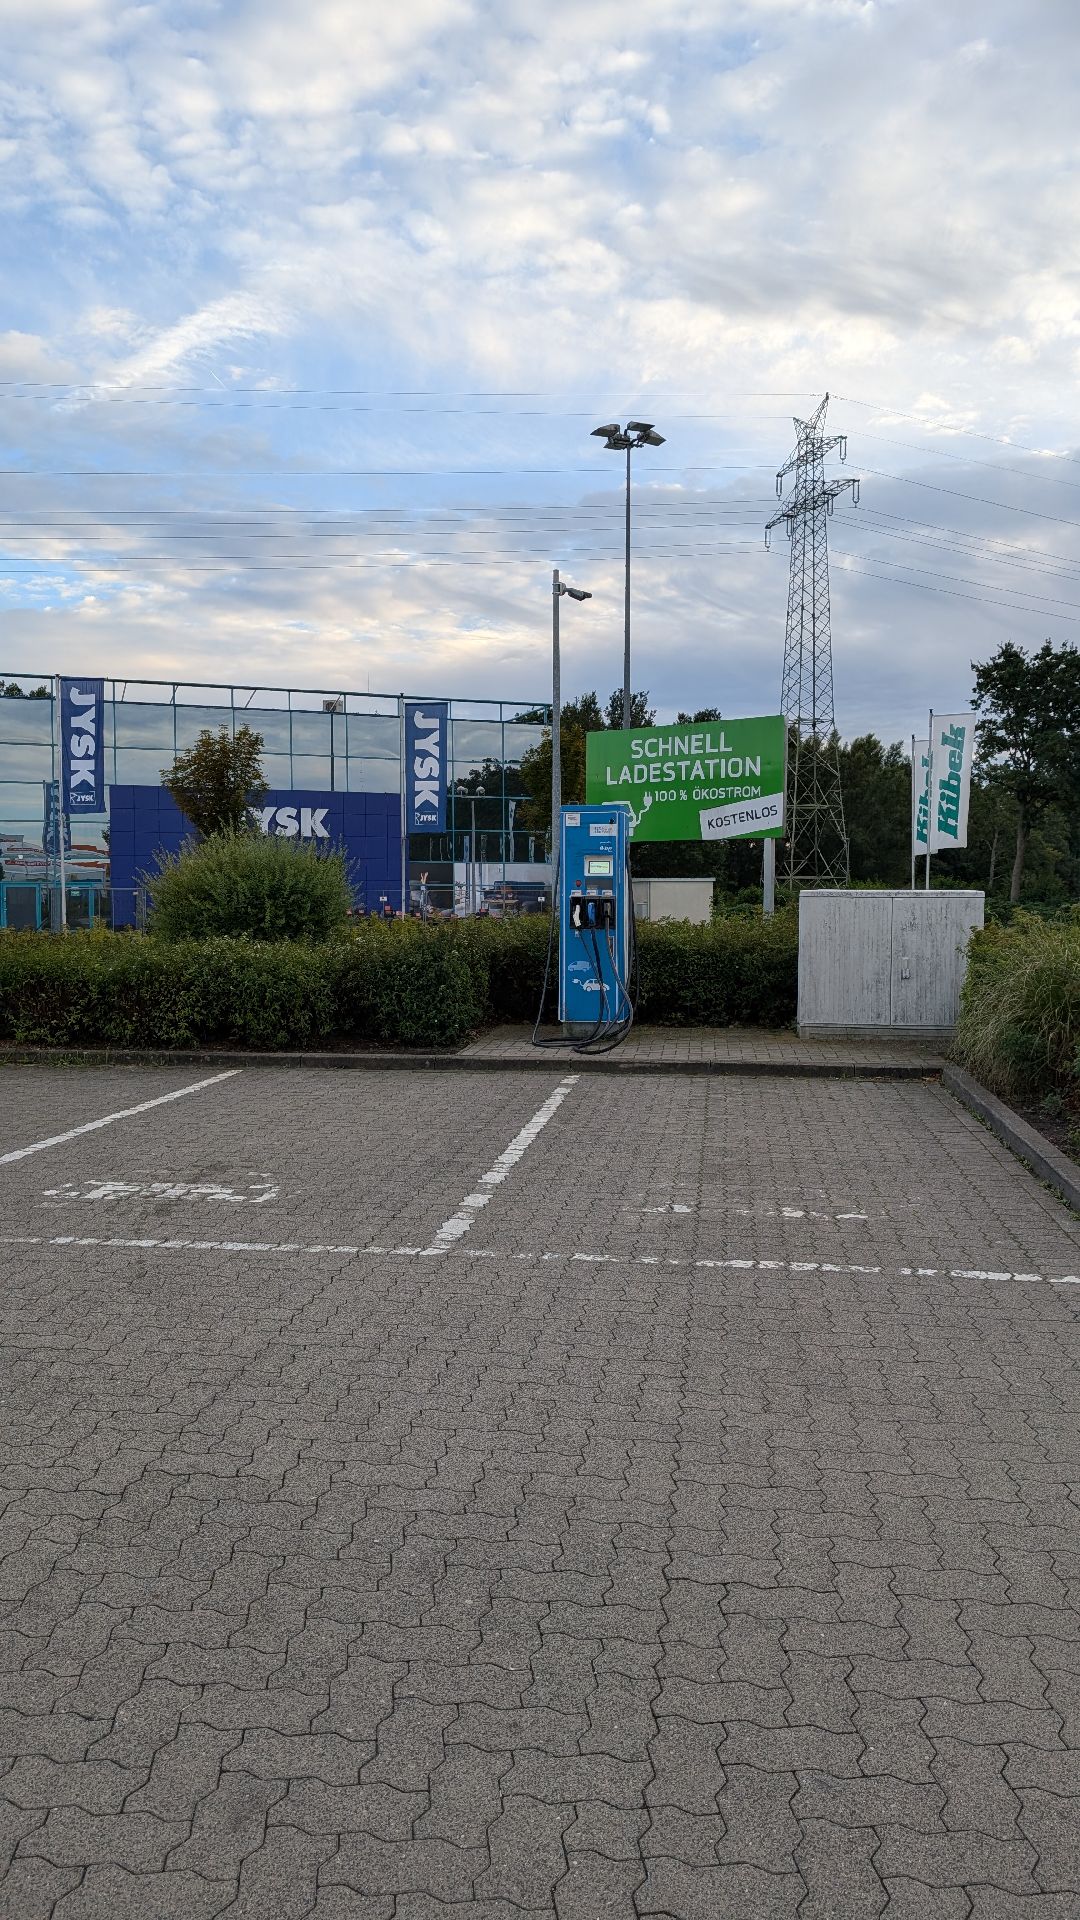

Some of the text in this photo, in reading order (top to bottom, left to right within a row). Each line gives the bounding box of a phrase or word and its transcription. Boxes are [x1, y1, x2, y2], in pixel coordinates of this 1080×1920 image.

[70, 687, 95, 788] JYSK
[631, 732, 733, 759] SCHNELL
[414, 711, 439, 809] JYSK
[606, 756, 761, 786] LADESTATION
[655, 786, 761, 802] 100 % ÖKOSTROM
[938, 723, 966, 840] Kibek
[240, 807, 331, 837] YSK
[707, 805, 778, 830] KOSTENLOS
